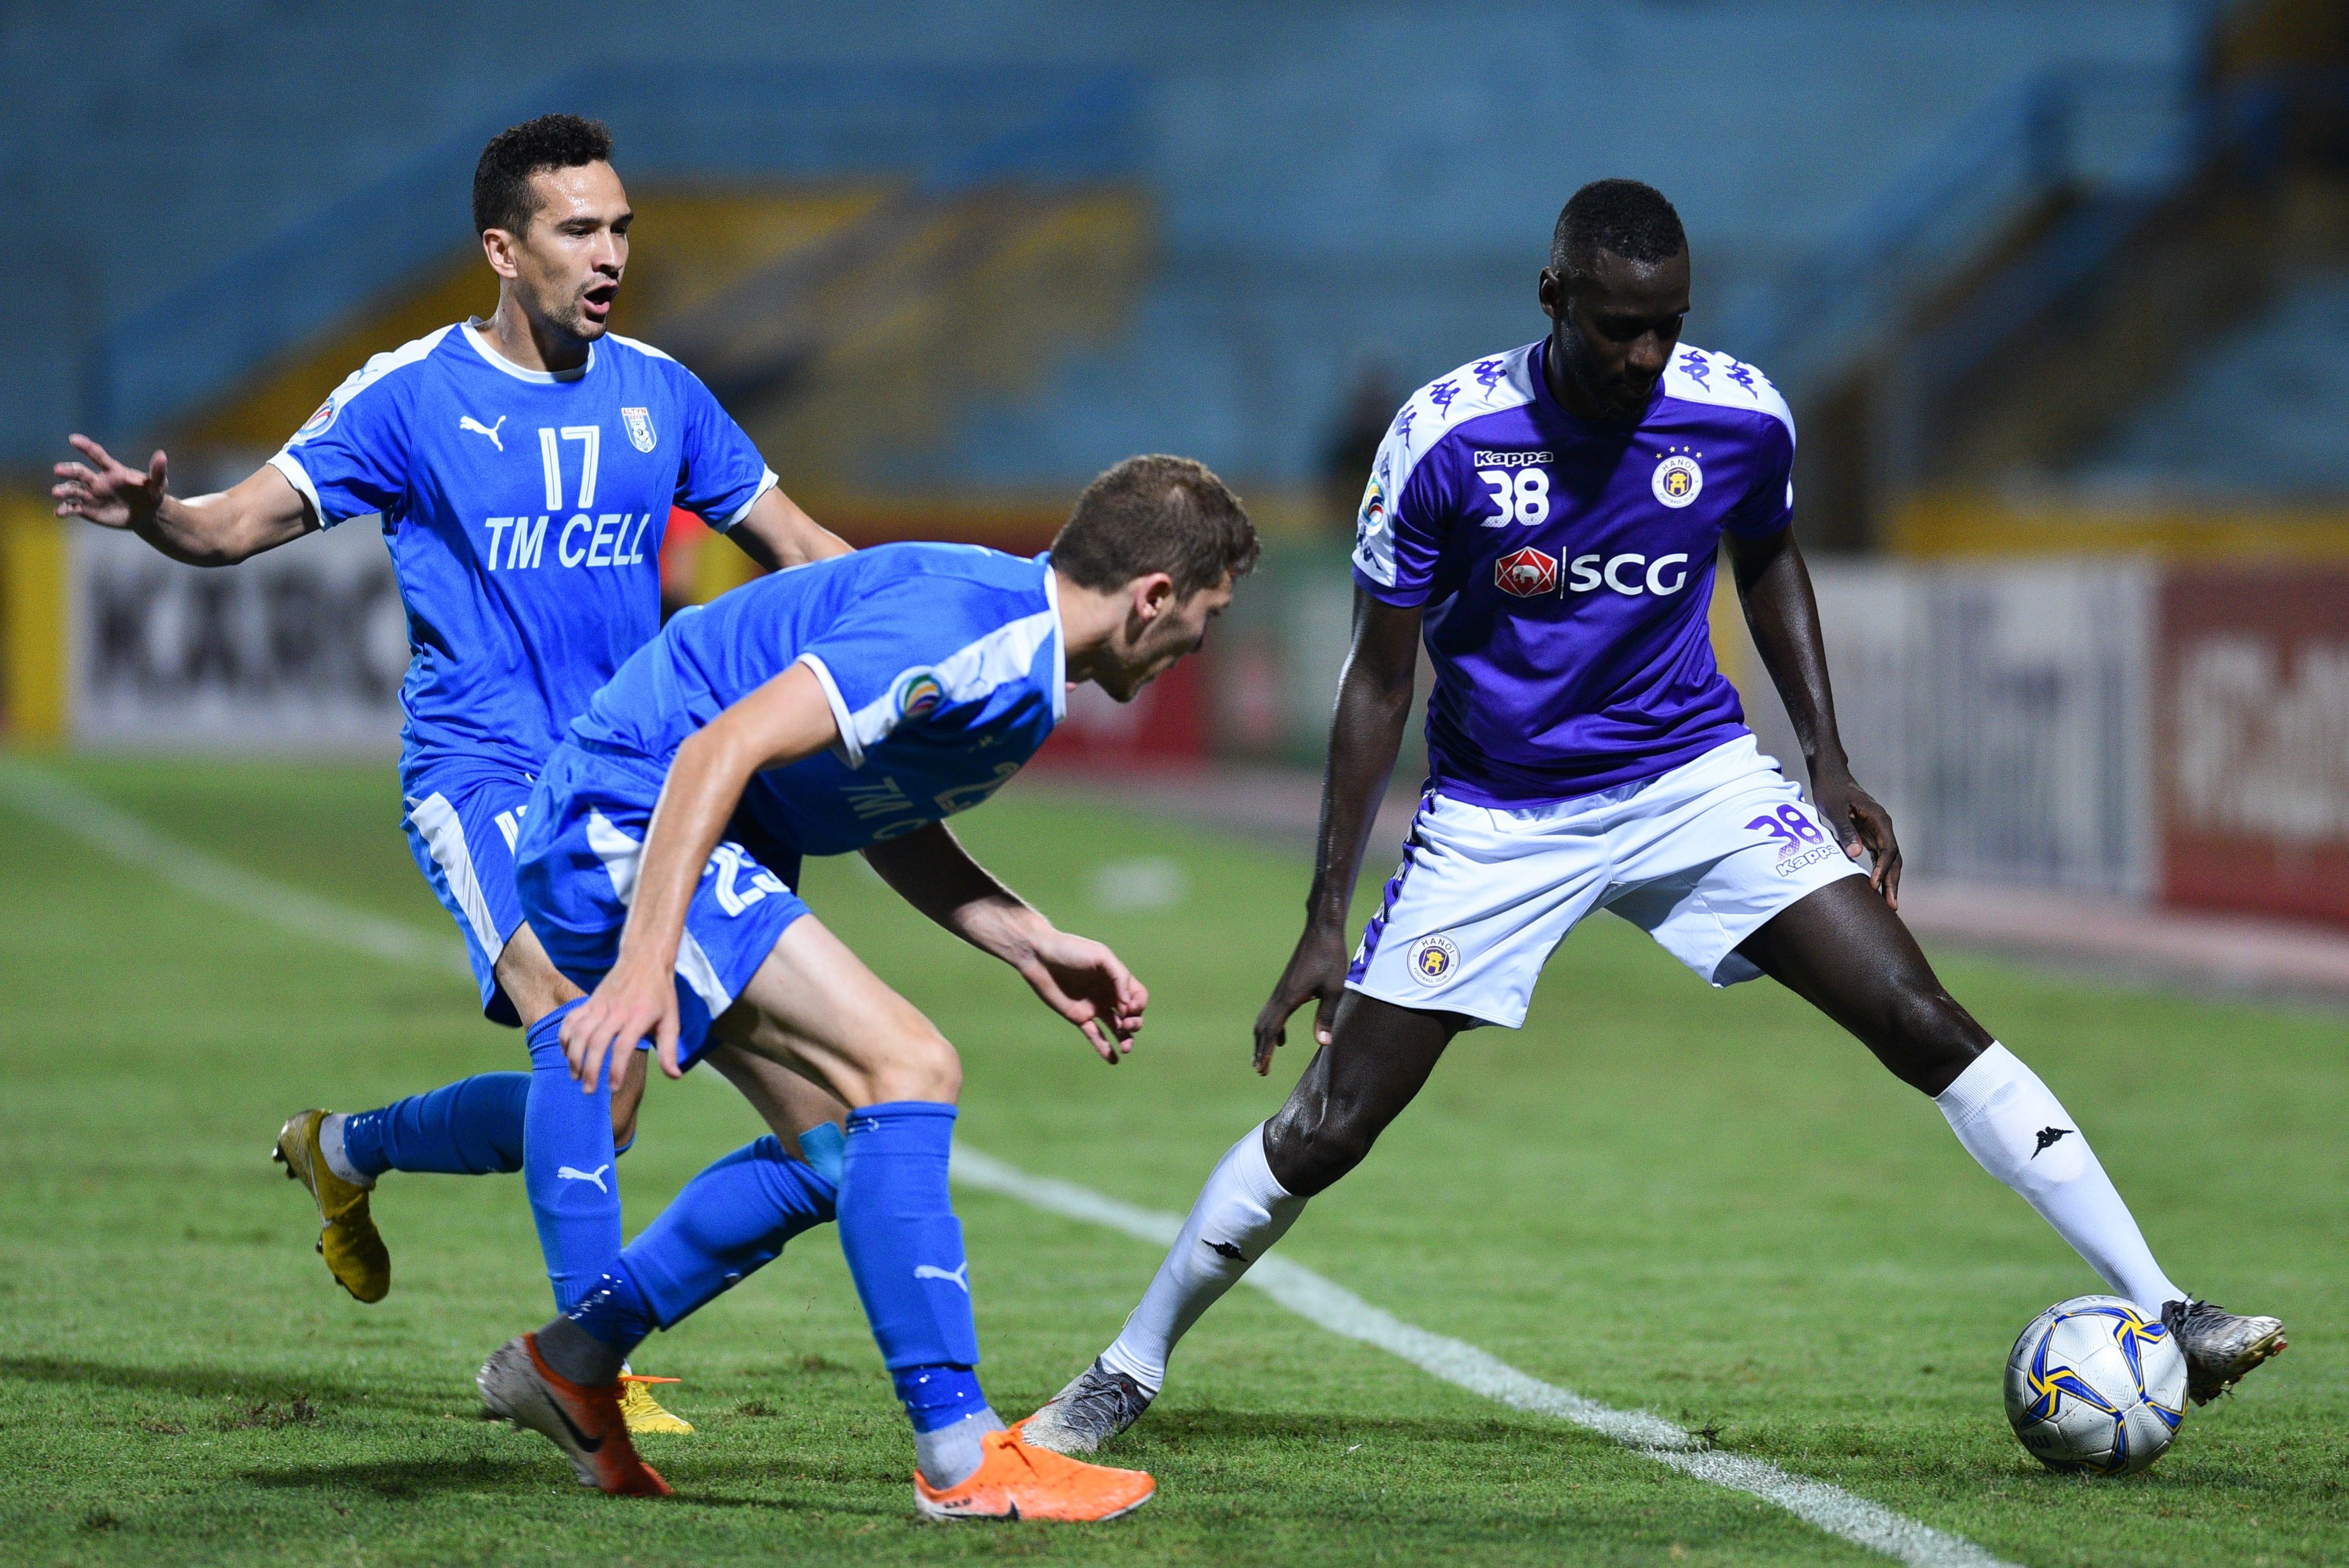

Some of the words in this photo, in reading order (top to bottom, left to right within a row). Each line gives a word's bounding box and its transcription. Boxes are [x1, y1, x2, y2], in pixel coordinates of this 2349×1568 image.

[538, 425, 600, 510] 17
[1474, 450, 1554, 467] Kappa
[1662, 459, 1695, 471] HANOI
[1477, 468, 1549, 528] 38
[485, 516, 550, 571] TM
[559, 514, 651, 568] CELL
[1570, 553, 1688, 596] SCG
[1743, 804, 1824, 862] 38
[1775, 845, 1841, 877] Kappa
[1421, 937, 1455, 954] HANOI
[1413, 967, 1434, 983] FOOTBALL
[1435, 974, 1447, 982] CLUB
